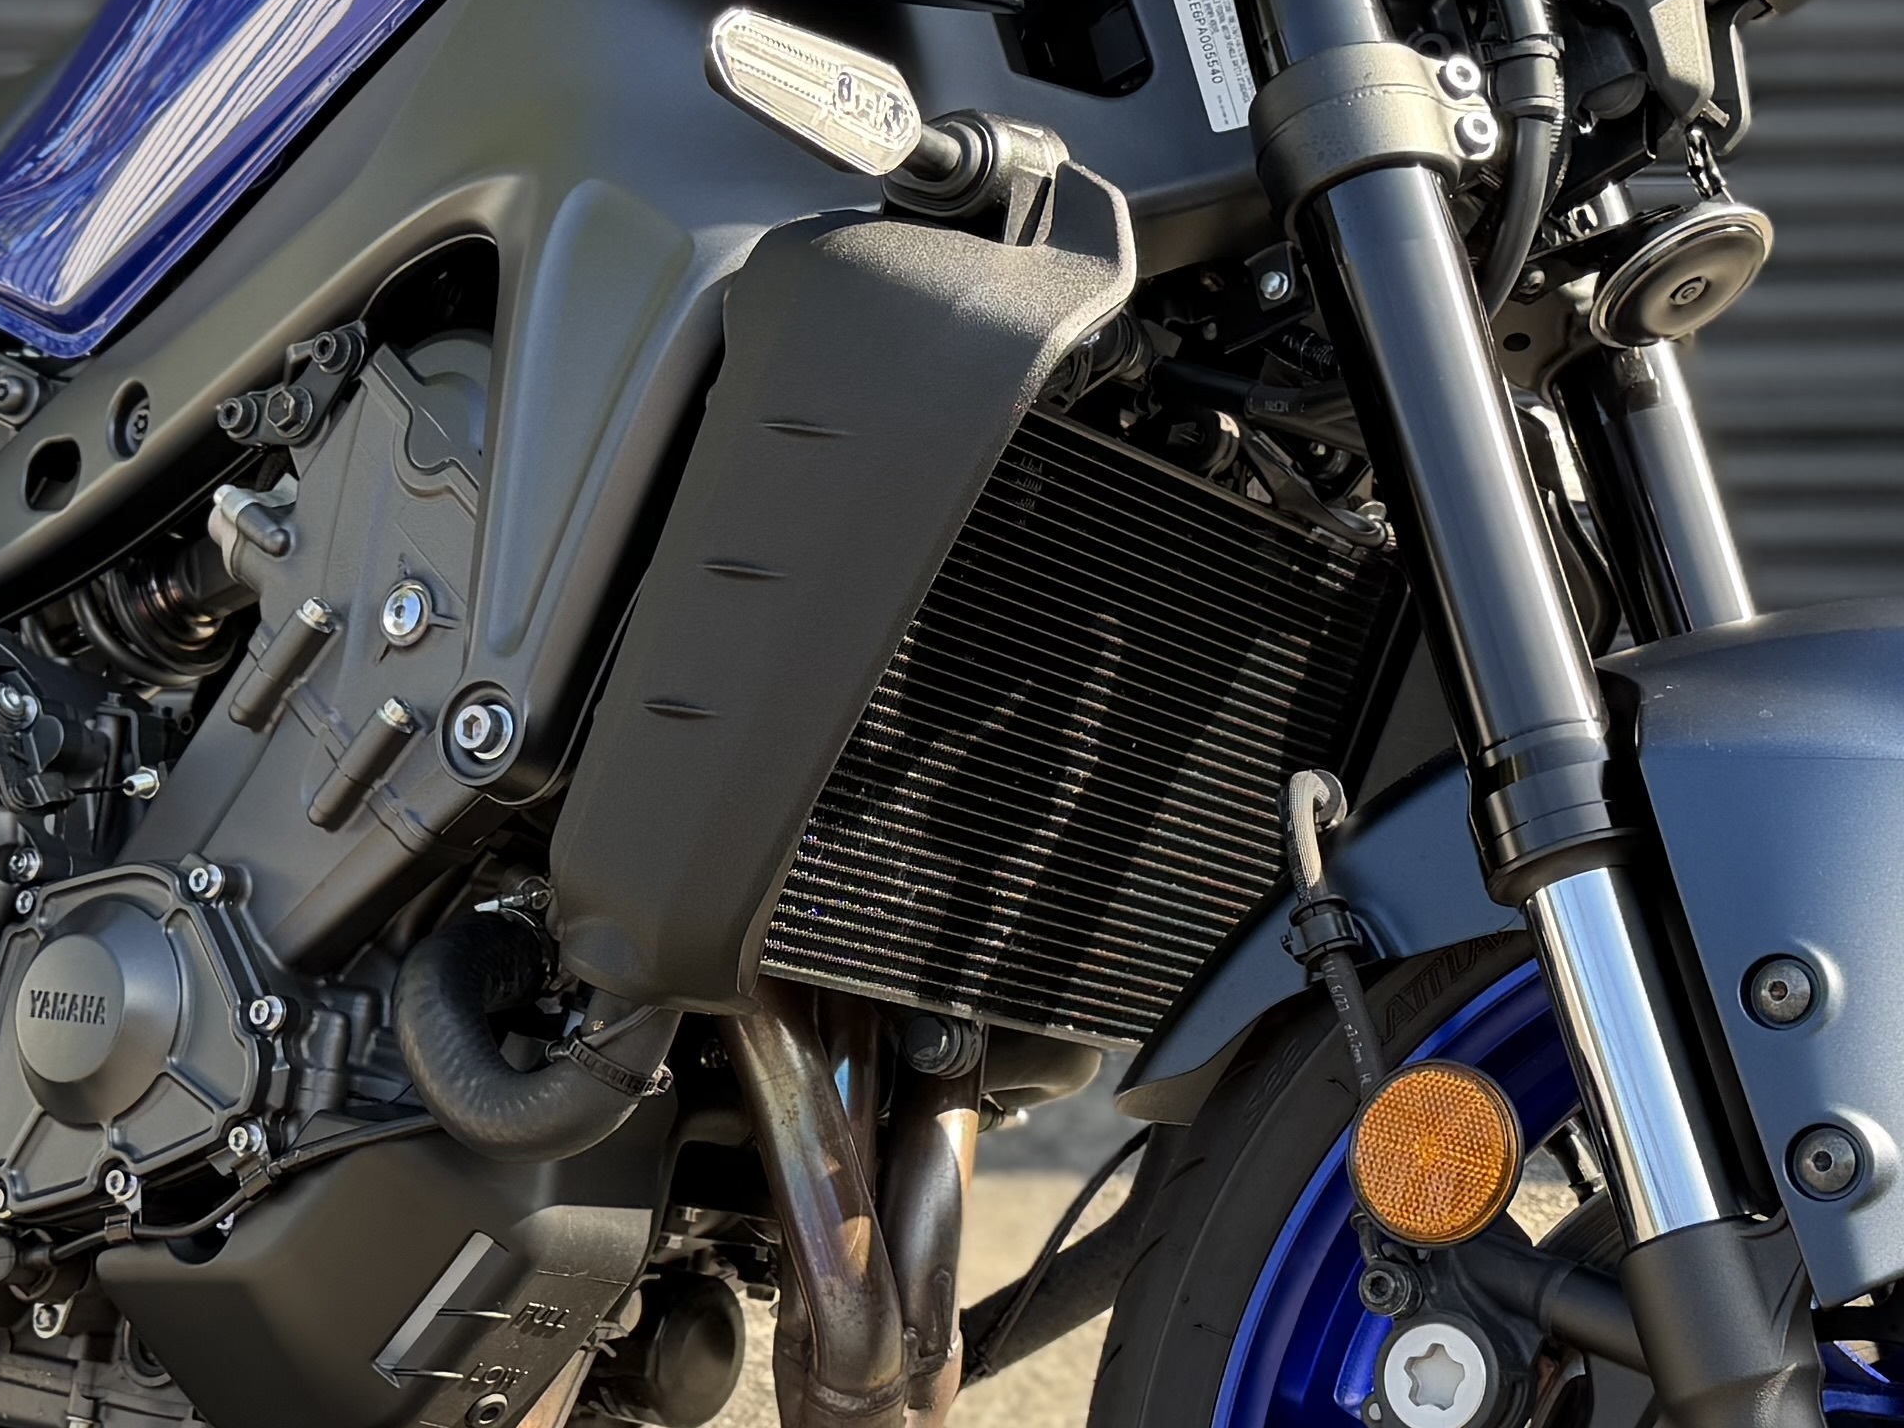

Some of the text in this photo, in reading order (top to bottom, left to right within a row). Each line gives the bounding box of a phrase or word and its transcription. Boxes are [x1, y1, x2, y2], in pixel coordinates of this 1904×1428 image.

[29, 988, 106, 1025] YAMAHA
[519, 1300, 571, 1330] FULL
[469, 1360, 530, 1386] LOW
